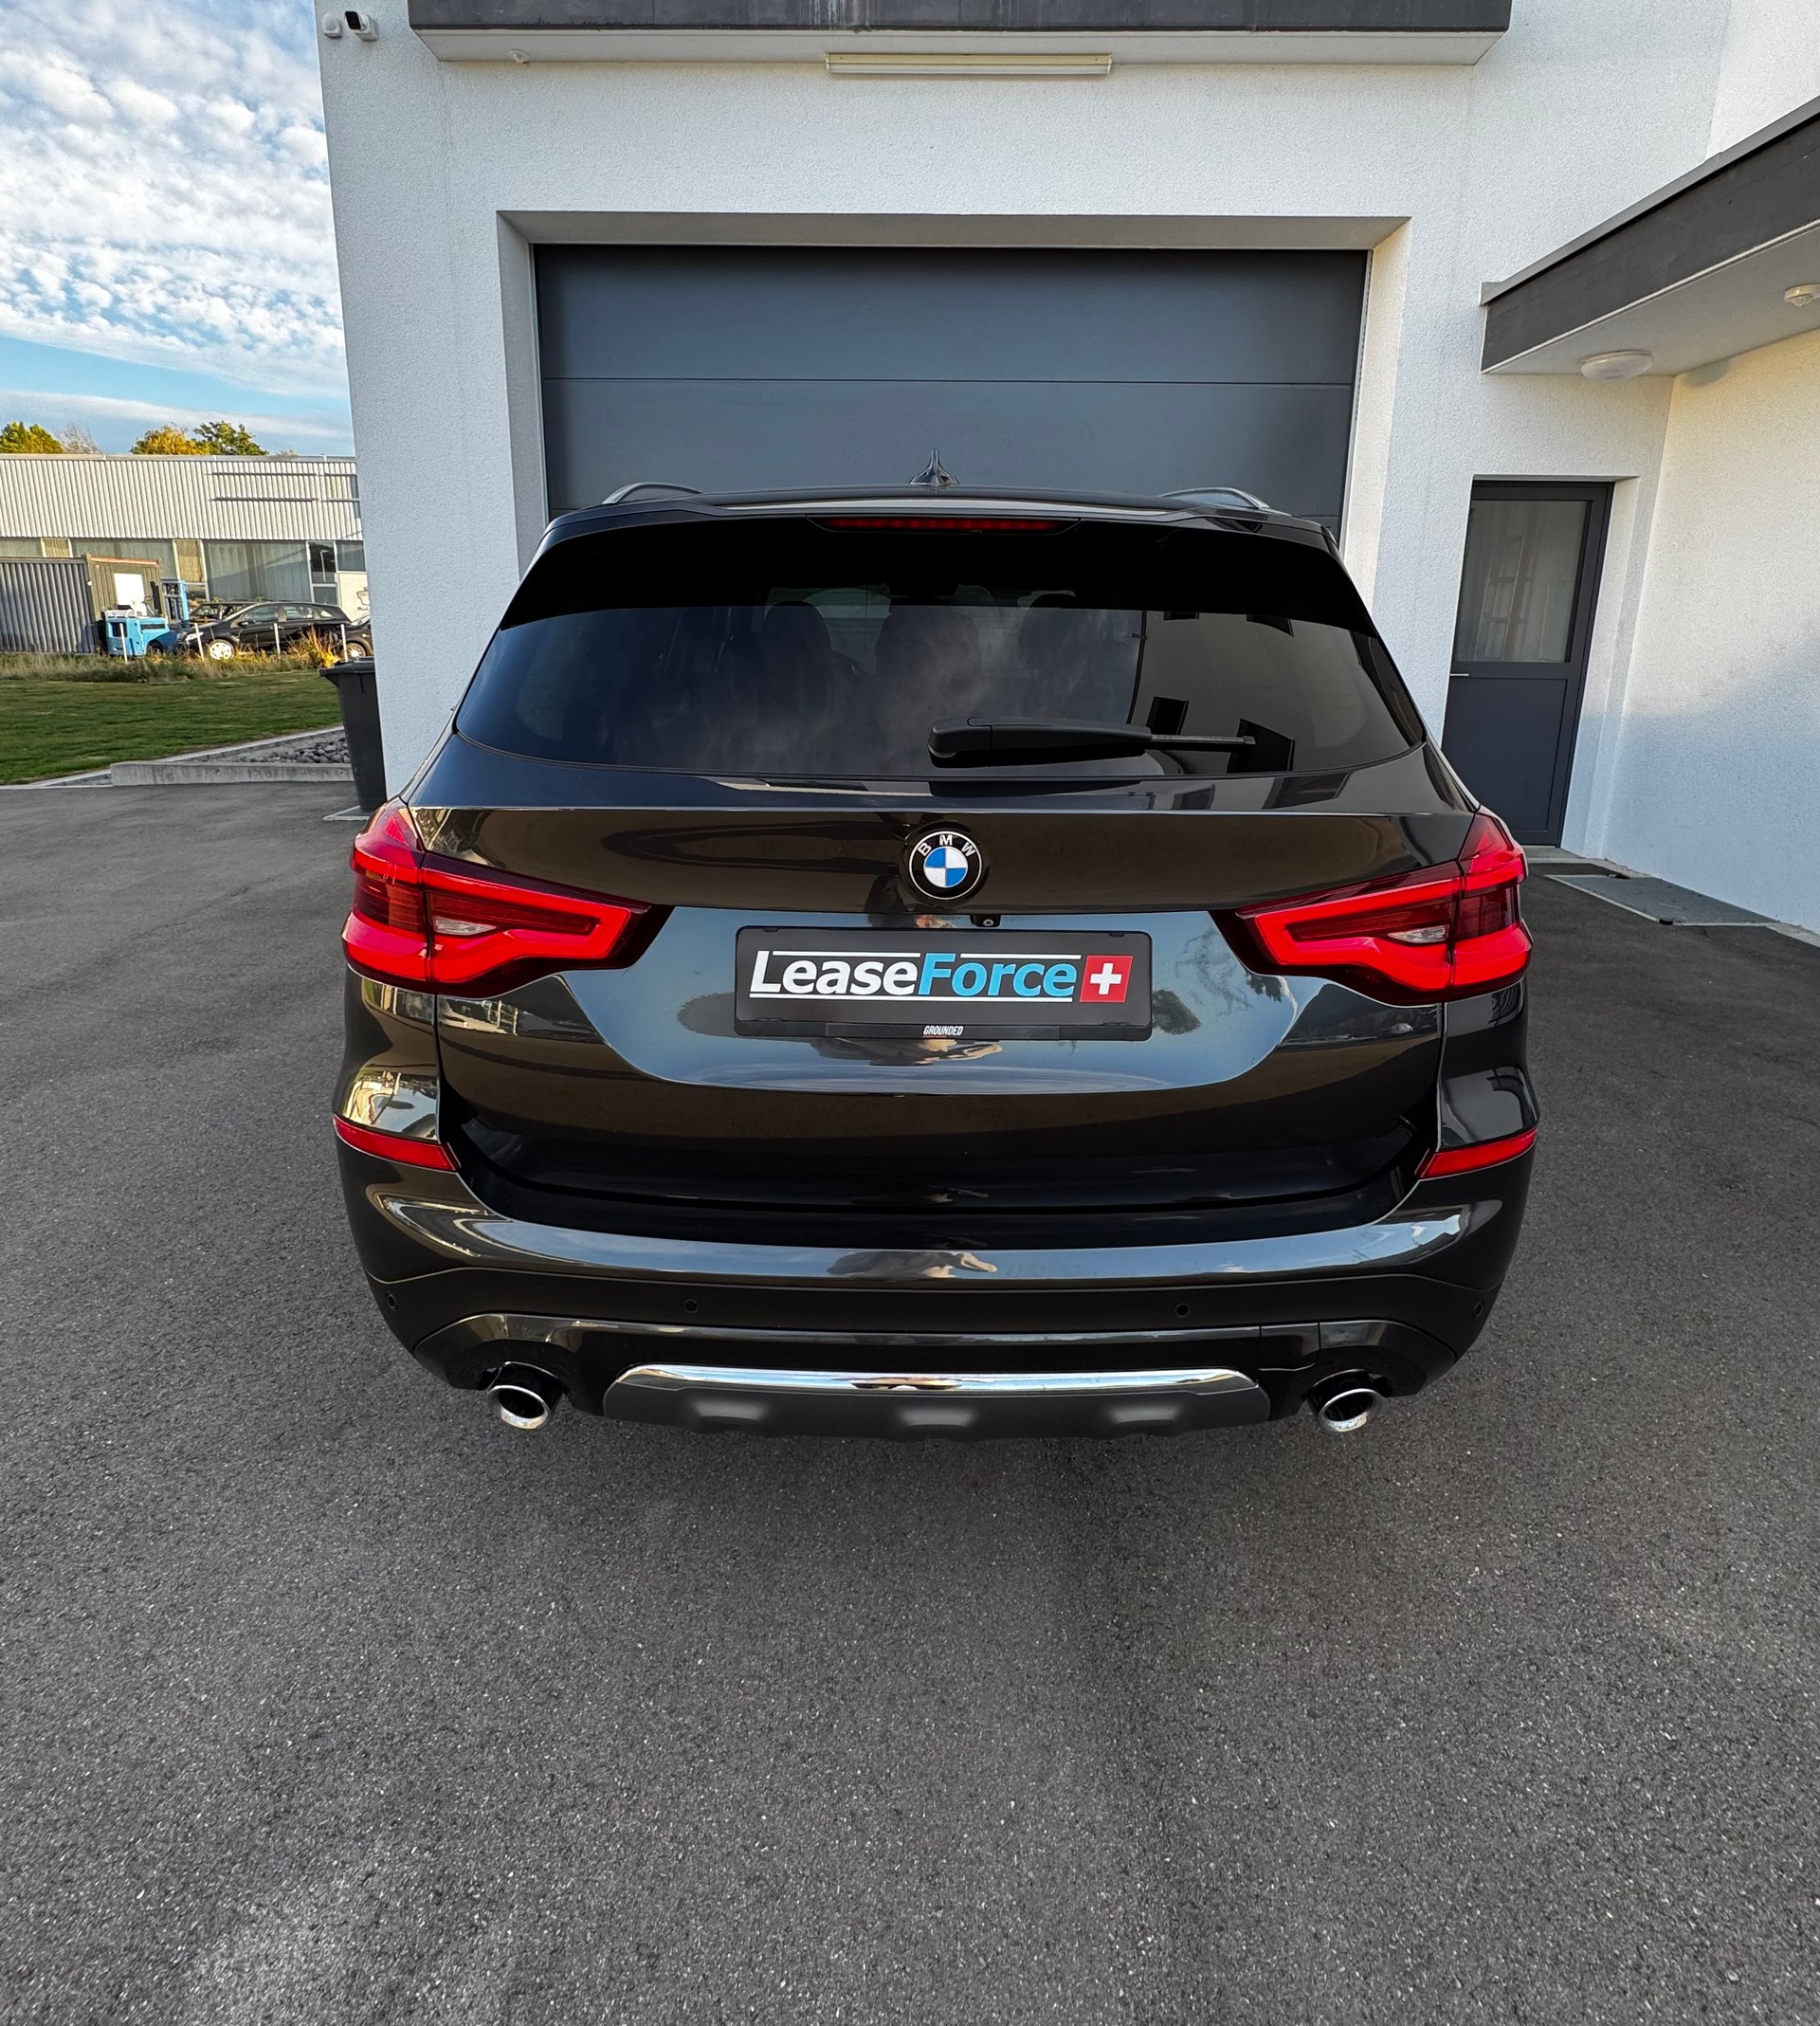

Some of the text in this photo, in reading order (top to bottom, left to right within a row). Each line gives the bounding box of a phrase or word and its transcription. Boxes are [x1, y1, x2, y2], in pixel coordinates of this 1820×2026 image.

[917, 834, 976, 857] BMW
[750, 950, 1078, 998] LeaseForce
[922, 1025, 964, 1036] GROUNDED
